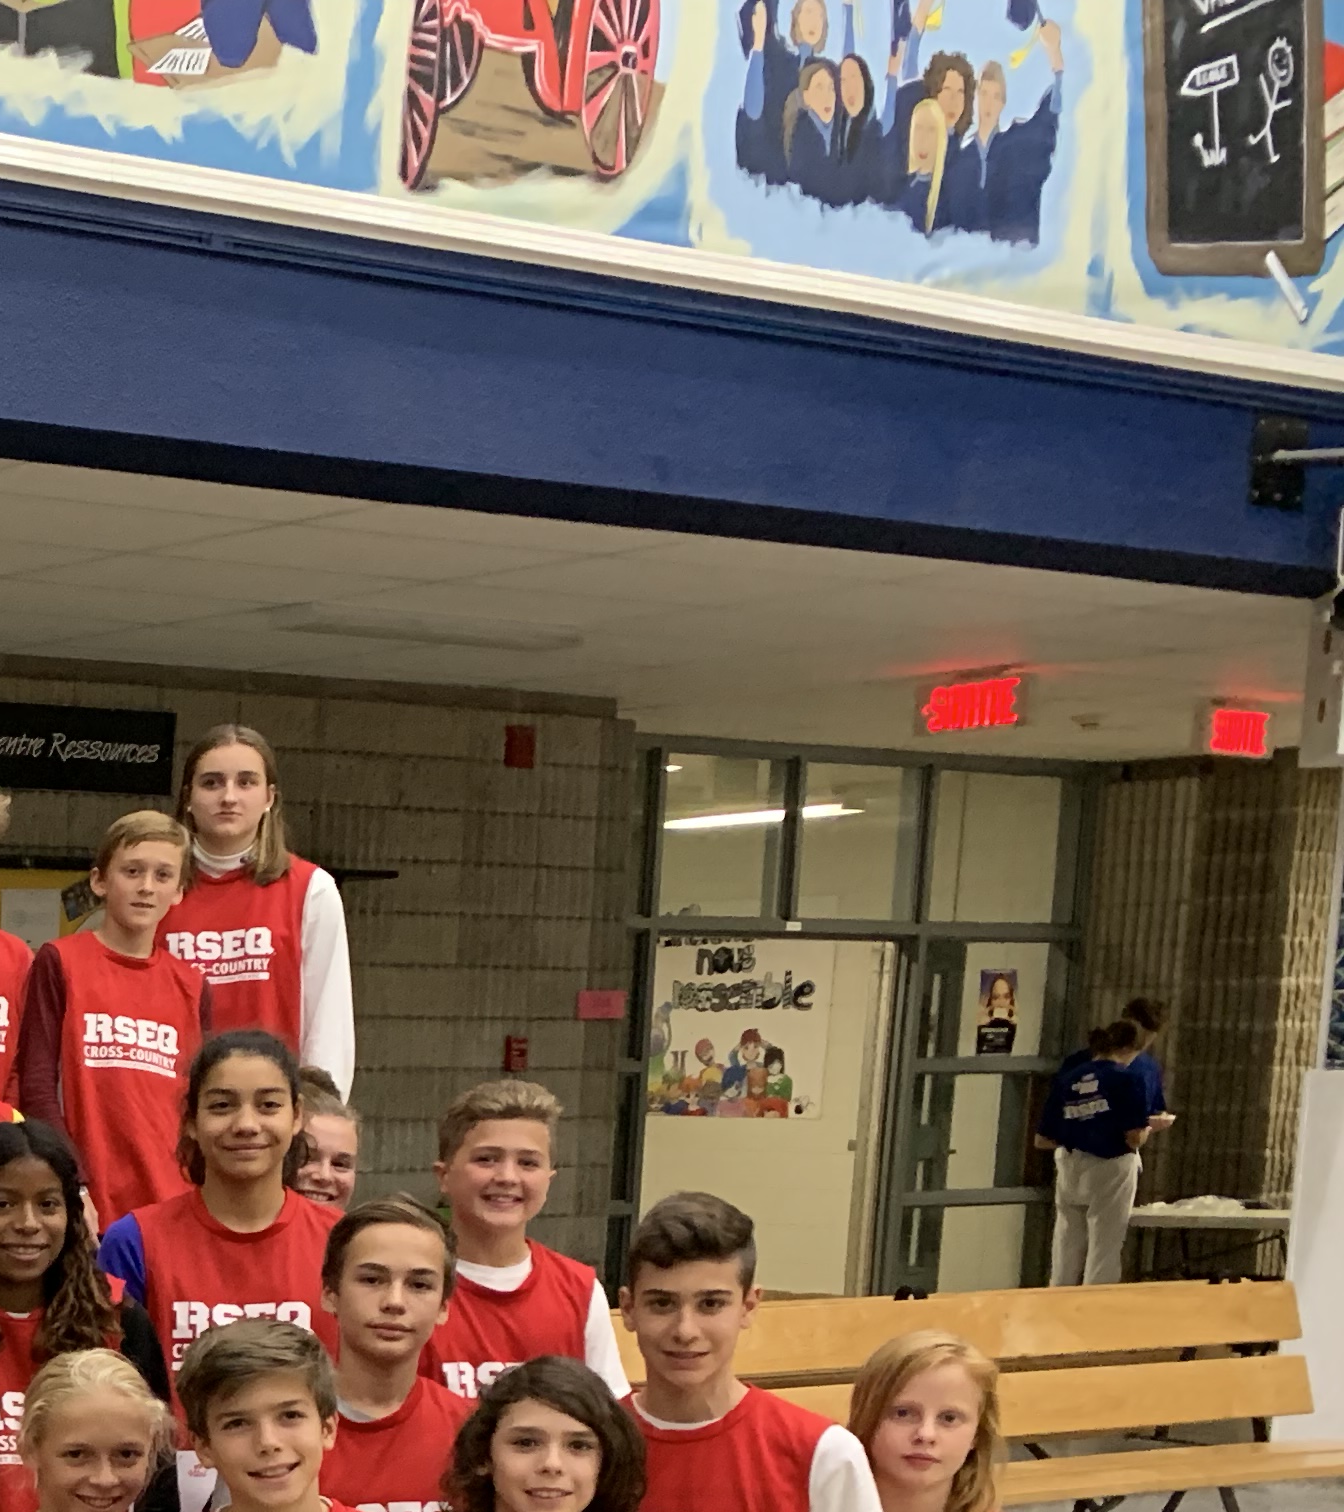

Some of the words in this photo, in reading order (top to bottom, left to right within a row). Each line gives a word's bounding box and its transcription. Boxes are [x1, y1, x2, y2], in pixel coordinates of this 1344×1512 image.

[48, 732, 160, 763] Ressources
[165, 926, 275, 961] RSEQ
[191, 958, 270, 975] S-COUNTRY
[83, 1012, 179, 1056] RSEQ
[83, 1044, 176, 1070] CROSS-COUNTRY
